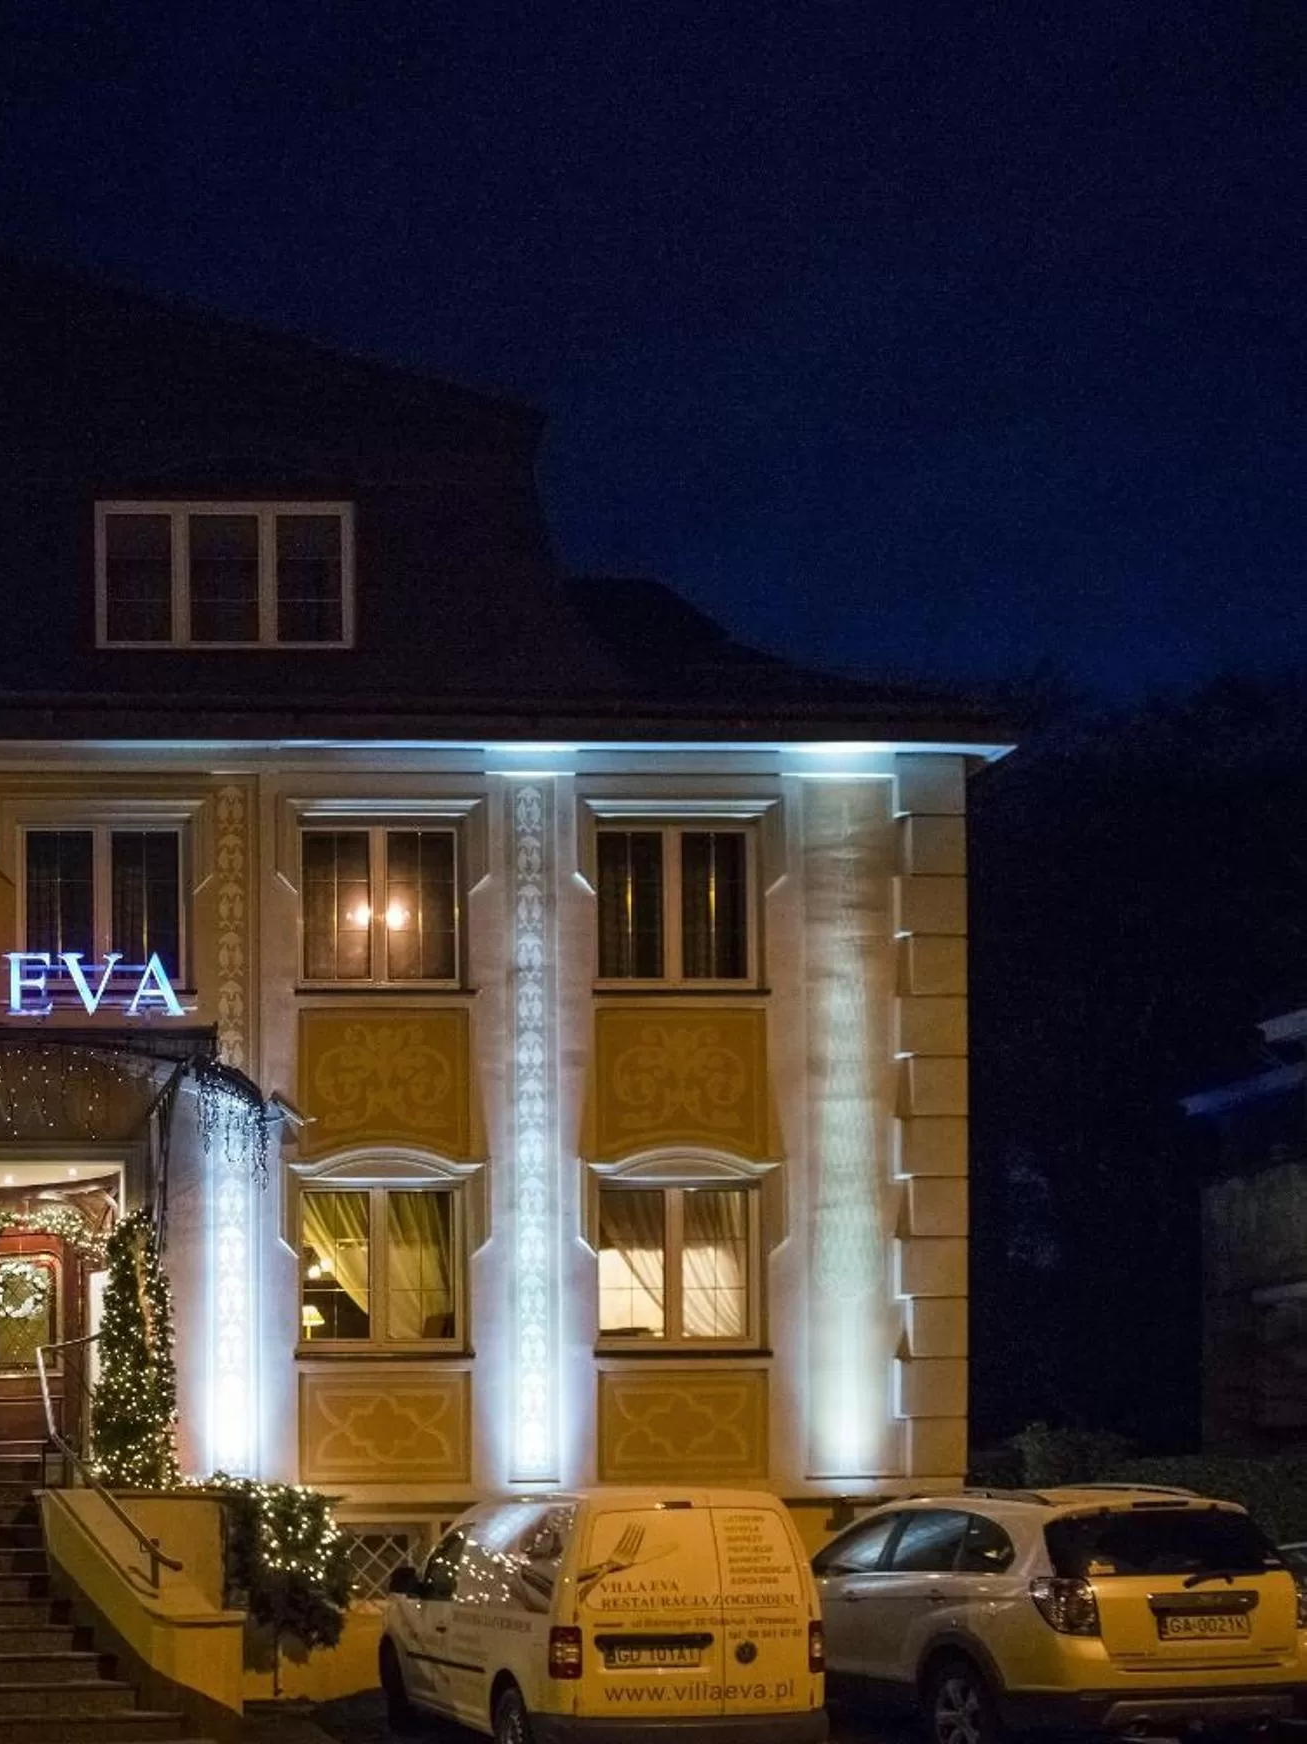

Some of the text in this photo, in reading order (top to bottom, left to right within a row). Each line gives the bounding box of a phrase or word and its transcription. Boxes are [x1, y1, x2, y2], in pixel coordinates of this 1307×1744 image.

[3, 950, 187, 1017] EVA
[600, 1579, 680, 1593] VILLA EVA
[601, 1595, 710, 1609] RESTAURACJA
[724, 1593, 799, 1607] OGRODEM
[1169, 1618, 1193, 1633] GA
[618, 1647, 641, 1662] GD
[604, 1680, 795, 1703] www.villaeva.pl
